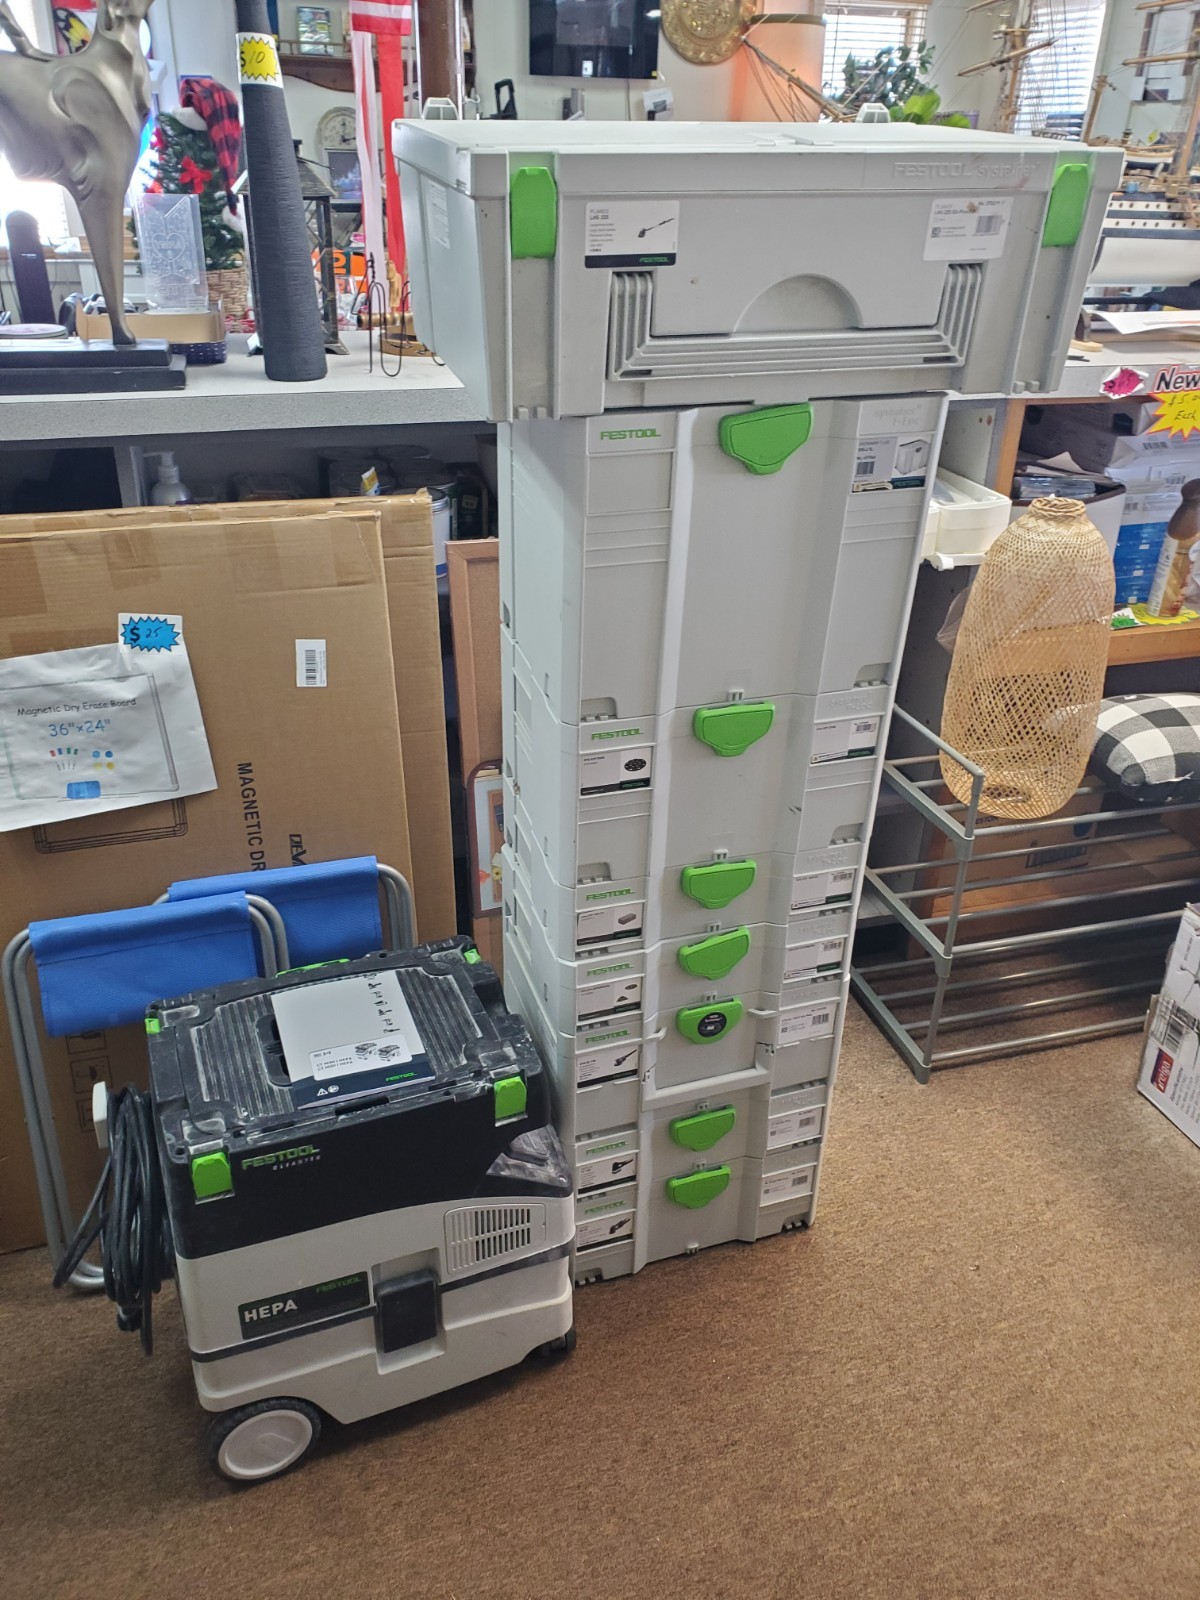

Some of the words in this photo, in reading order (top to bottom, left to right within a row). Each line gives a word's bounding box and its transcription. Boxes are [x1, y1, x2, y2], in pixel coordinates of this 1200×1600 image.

[600, 428, 662, 441] FESTOOL
[145, 626, 163, 639] 25
[17, 704, 61, 717] Magnetic
[64, 702, 80, 713] Dry
[83, 702, 108, 711] Erase
[110, 698, 137, 709] Board
[591, 728, 645, 741] FESTOOL
[237, 762, 264, 847] MAGNETIC
[585, 888, 636, 901] FESTOOL
[587, 962, 635, 977] FESTOOL
[585, 1029, 631, 1044] FESTOOL
[385, 1072, 418, 1082] FESTOOL
[585, 1141, 629, 1155] FESTOOL
[241, 1145, 321, 1170] FESTOOL
[584, 1200, 628, 1215] FESTOOL
[316, 1277, 363, 1294] FESTOOL
[244, 1299, 298, 1323] HEPA
